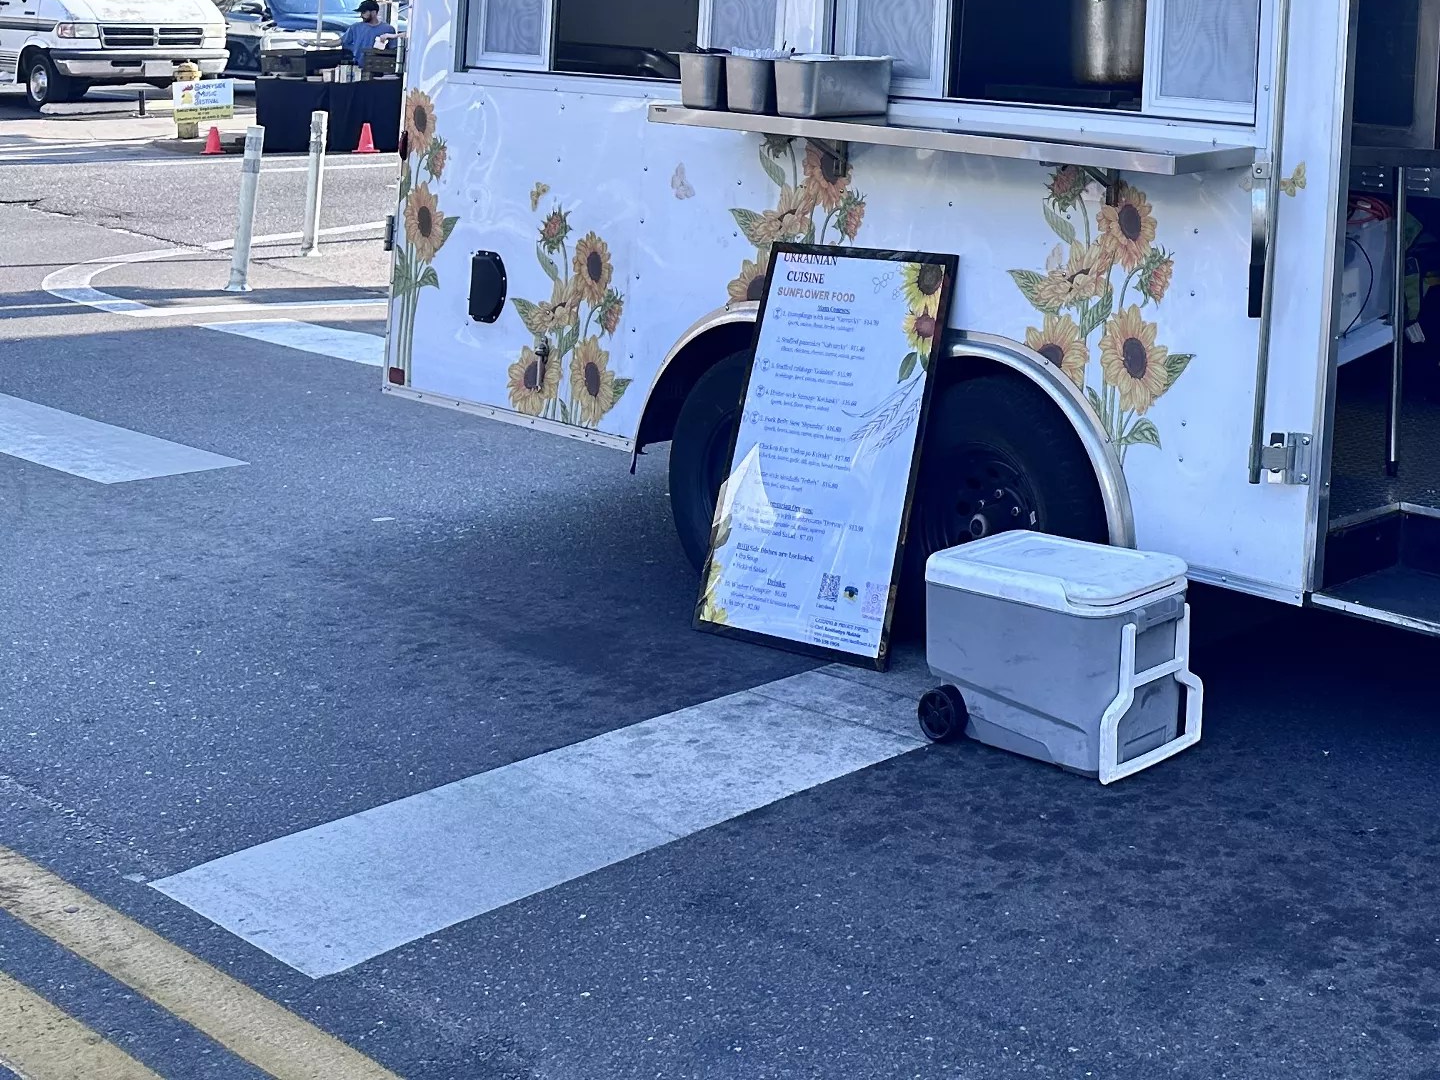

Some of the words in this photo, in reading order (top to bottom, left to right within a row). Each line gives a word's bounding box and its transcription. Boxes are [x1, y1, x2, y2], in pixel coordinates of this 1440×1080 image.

[784, 252, 838, 266] UKRAINIAN
[786, 270, 825, 284] CUISINE
[777, 286, 830, 300] SUNFLOWER
[832, 291, 856, 303] FOOD
